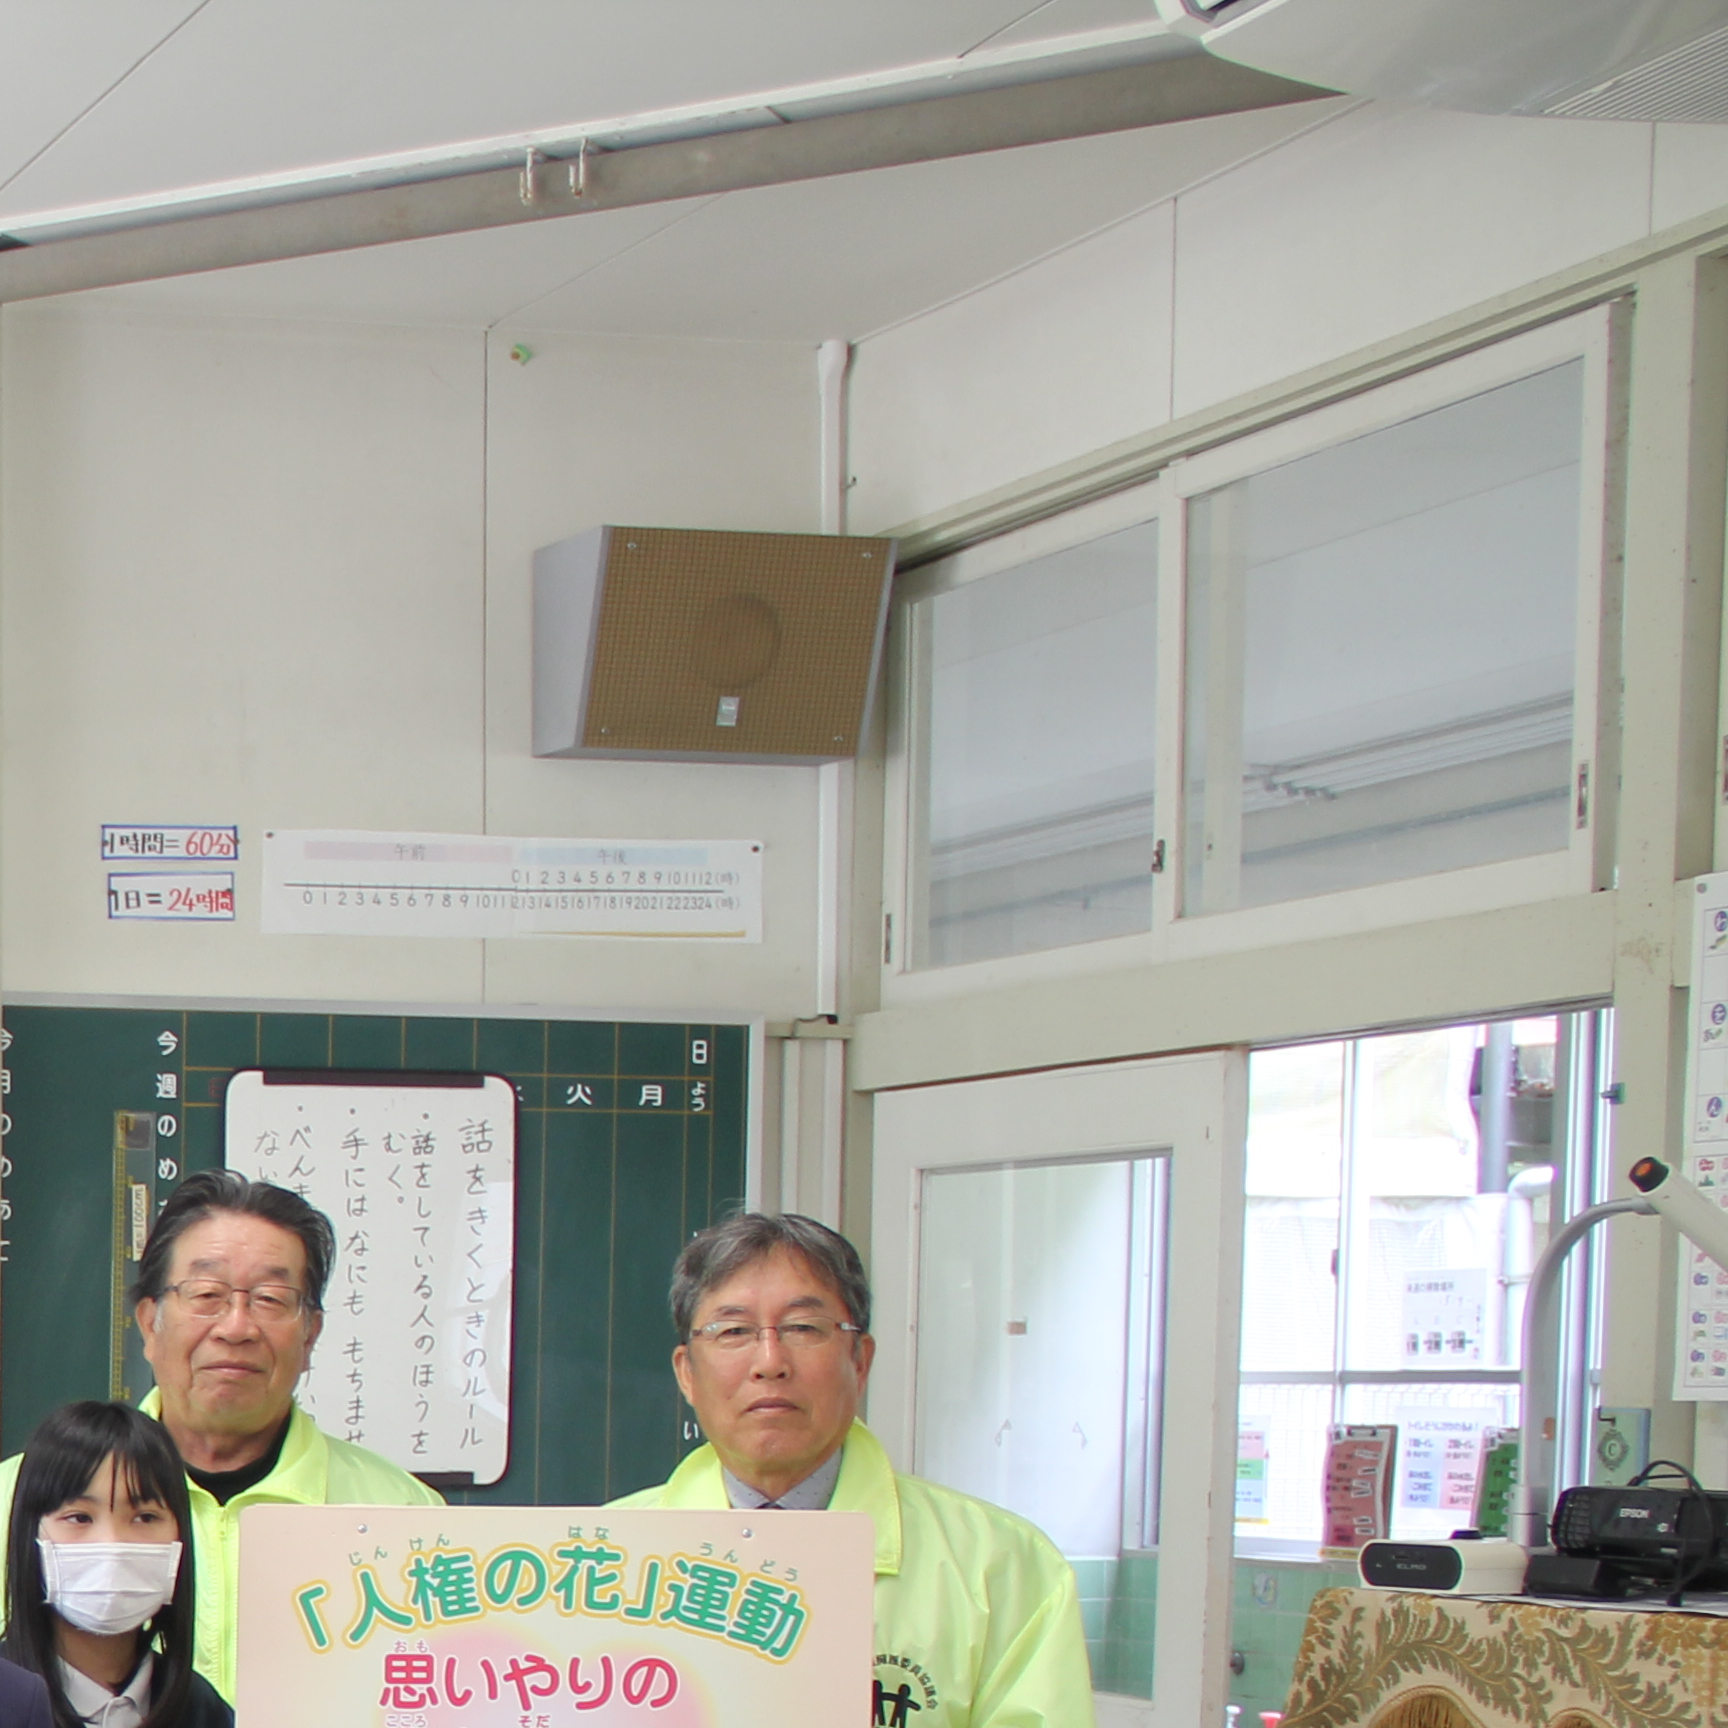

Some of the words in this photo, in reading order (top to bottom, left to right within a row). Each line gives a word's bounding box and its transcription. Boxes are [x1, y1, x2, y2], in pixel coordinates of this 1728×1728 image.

[394, 843, 426, 861] 午前
[596, 847, 628, 866] 午後
[565, 1083, 593, 1106] 火
[638, 1084, 663, 1107] 月
[458, 1118, 495, 1450] 話をきくときのルール
[1619, 1507, 1650, 1519] EPSON
[298, 1544, 807, 1658] 「人権の花」運動
[378, 1653, 680, 1712] 思いやりの
